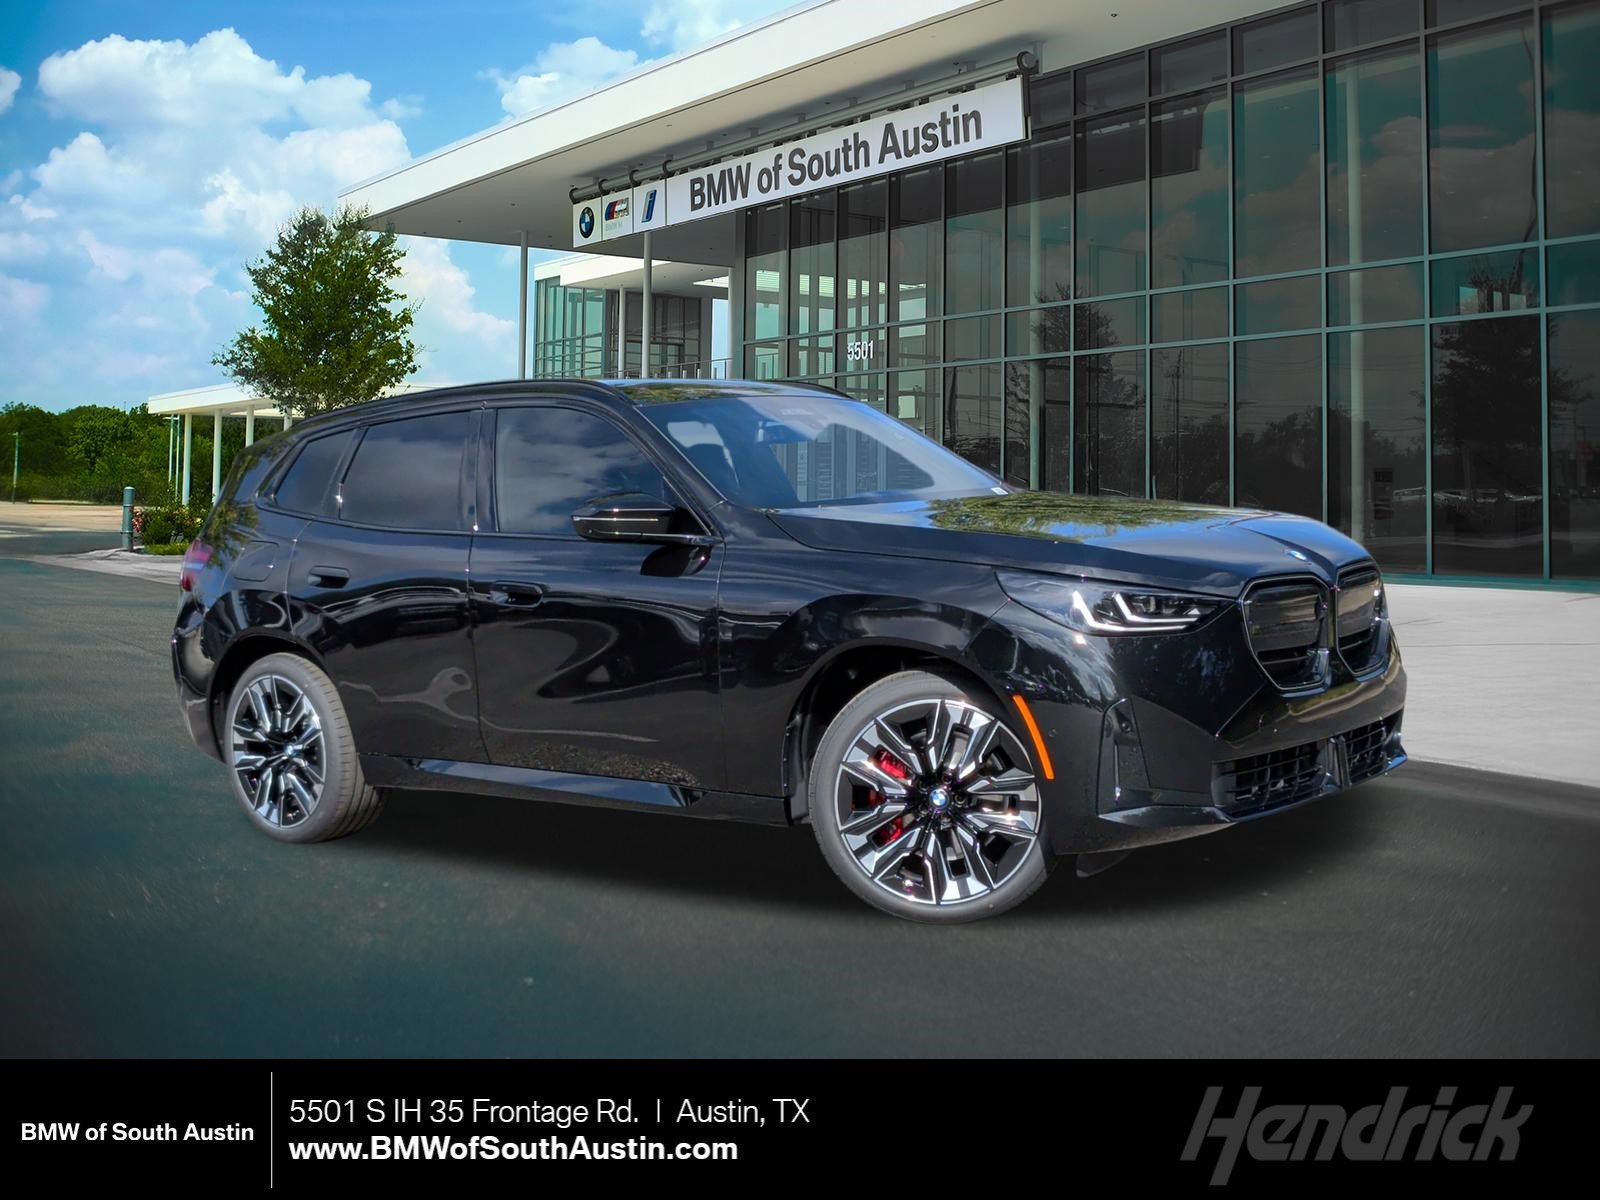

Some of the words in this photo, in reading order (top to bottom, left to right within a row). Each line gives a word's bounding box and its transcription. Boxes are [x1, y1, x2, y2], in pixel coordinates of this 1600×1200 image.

[690, 162, 752, 212] BMW
[757, 153, 783, 194] of
[787, 131, 871, 187] South
[878, 103, 983, 164] Austin
[847, 340, 874, 361] 5501
